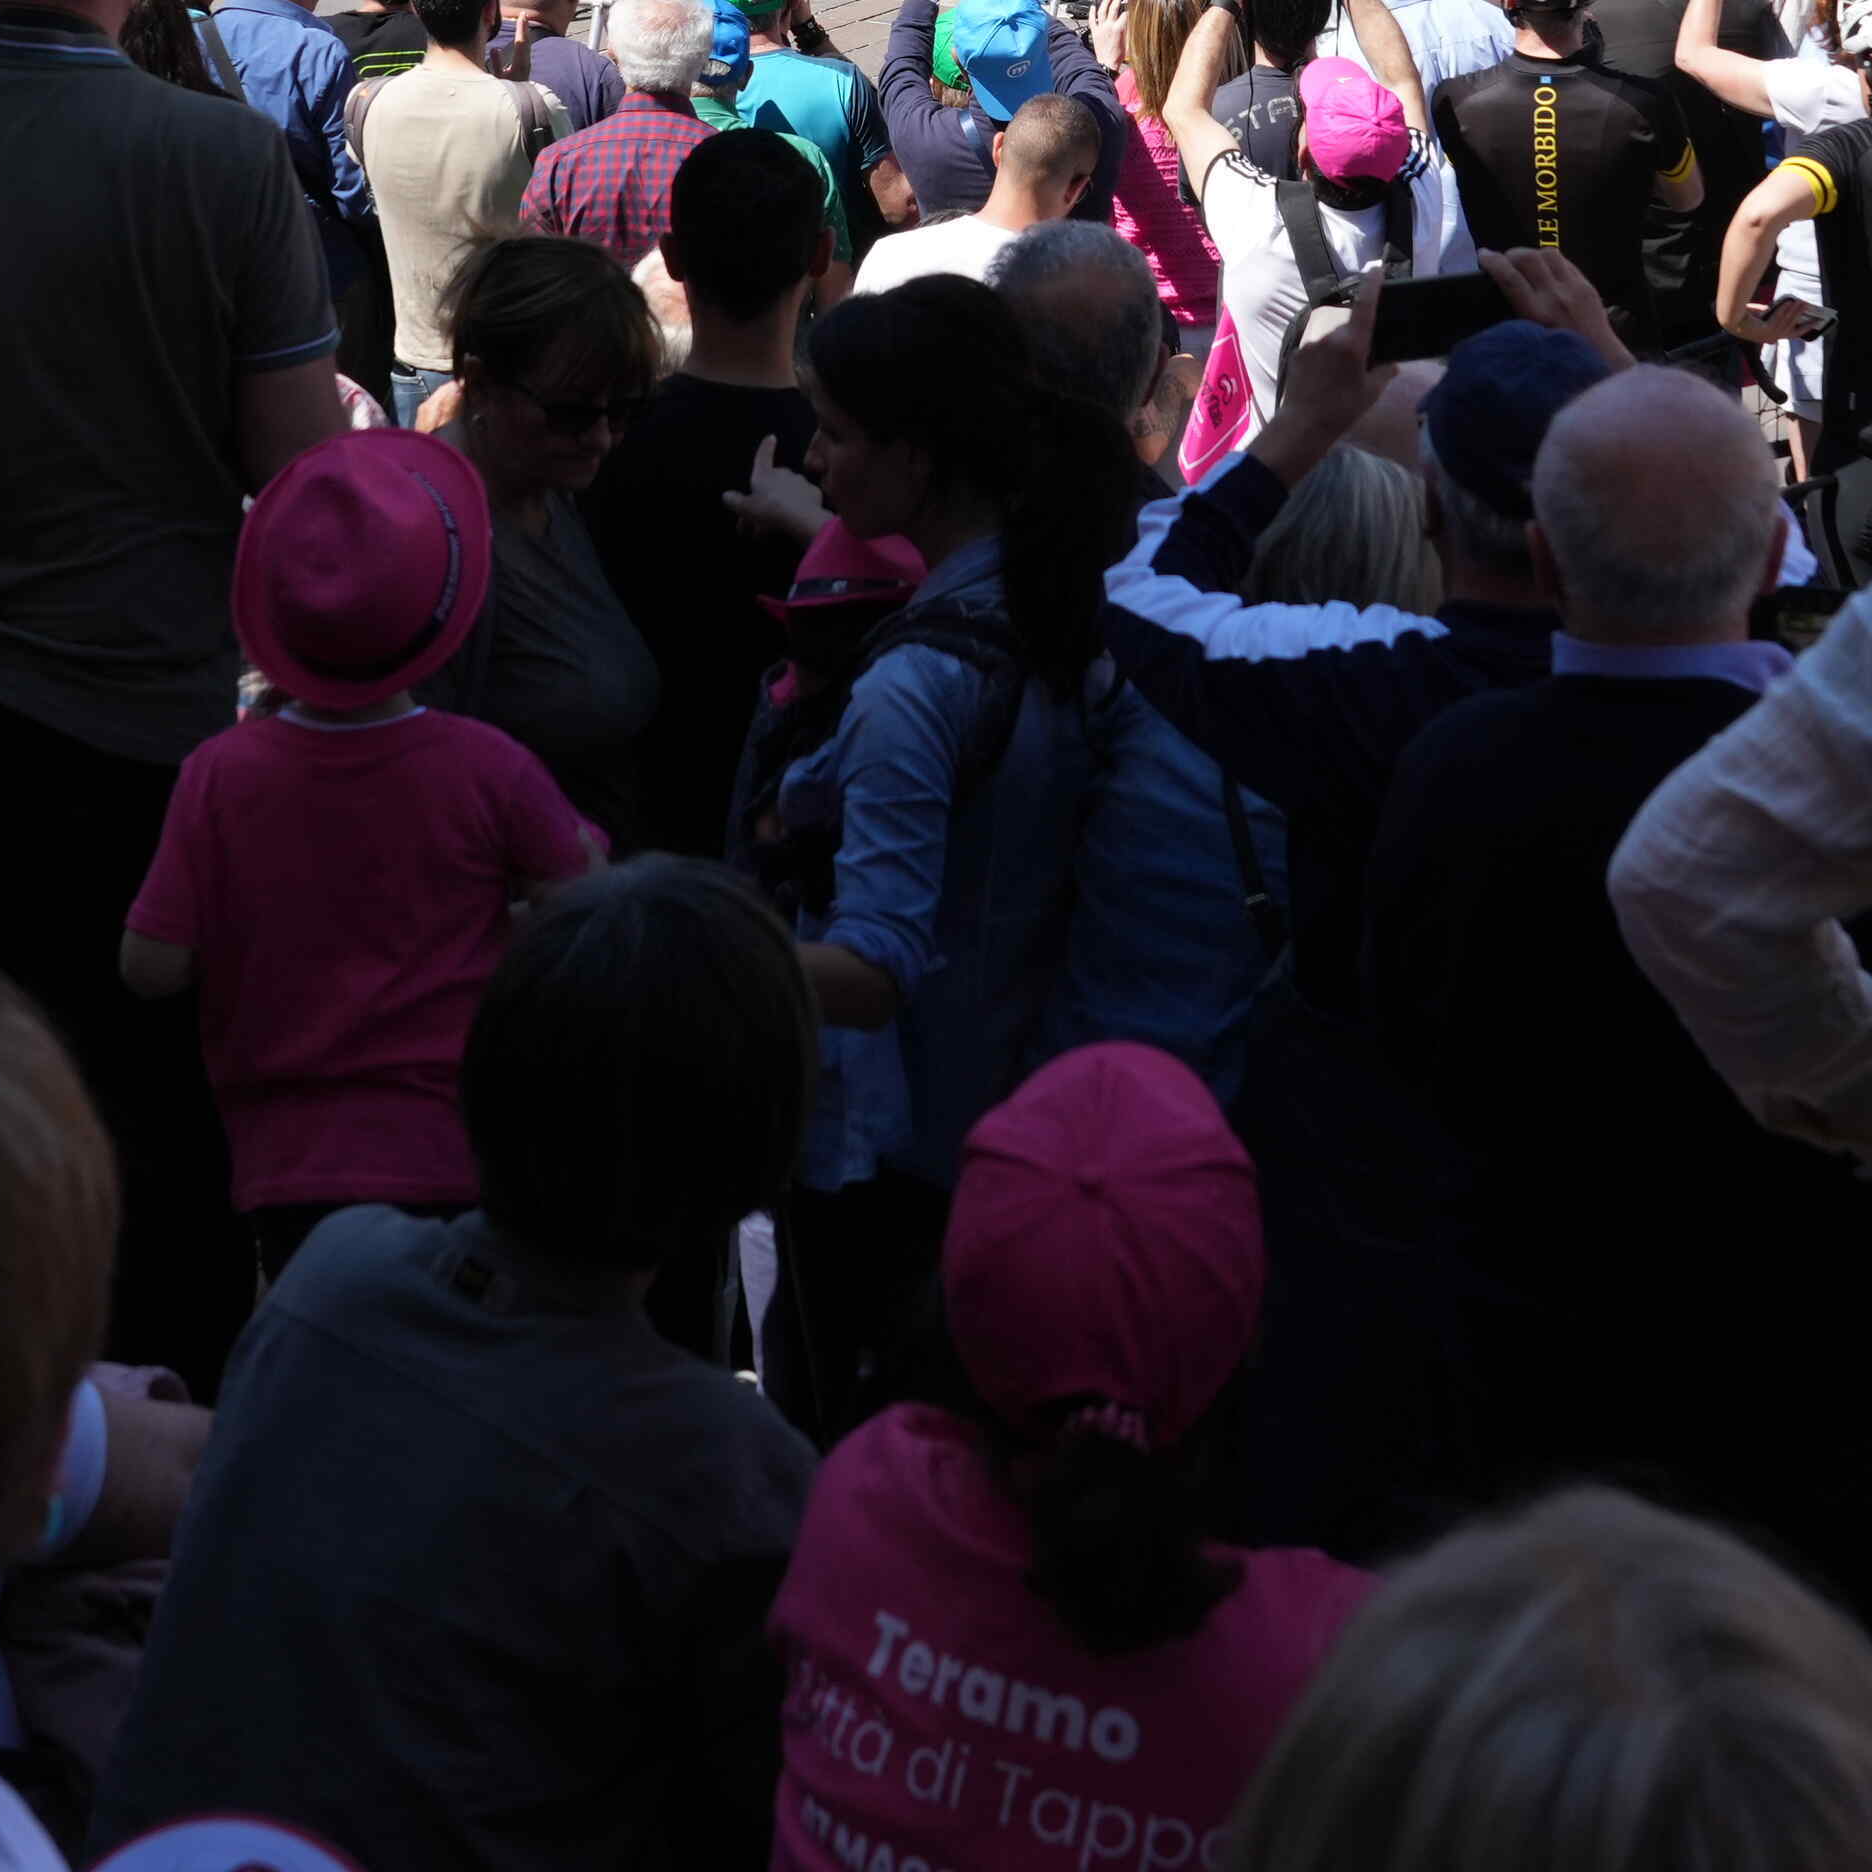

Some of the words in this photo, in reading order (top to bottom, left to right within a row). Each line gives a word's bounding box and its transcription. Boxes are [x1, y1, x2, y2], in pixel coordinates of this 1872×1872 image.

[1534, 86, 1558, 213] MORBIDO
[866, 1609, 1141, 1764] Teramo
[905, 1738, 972, 1810] di
